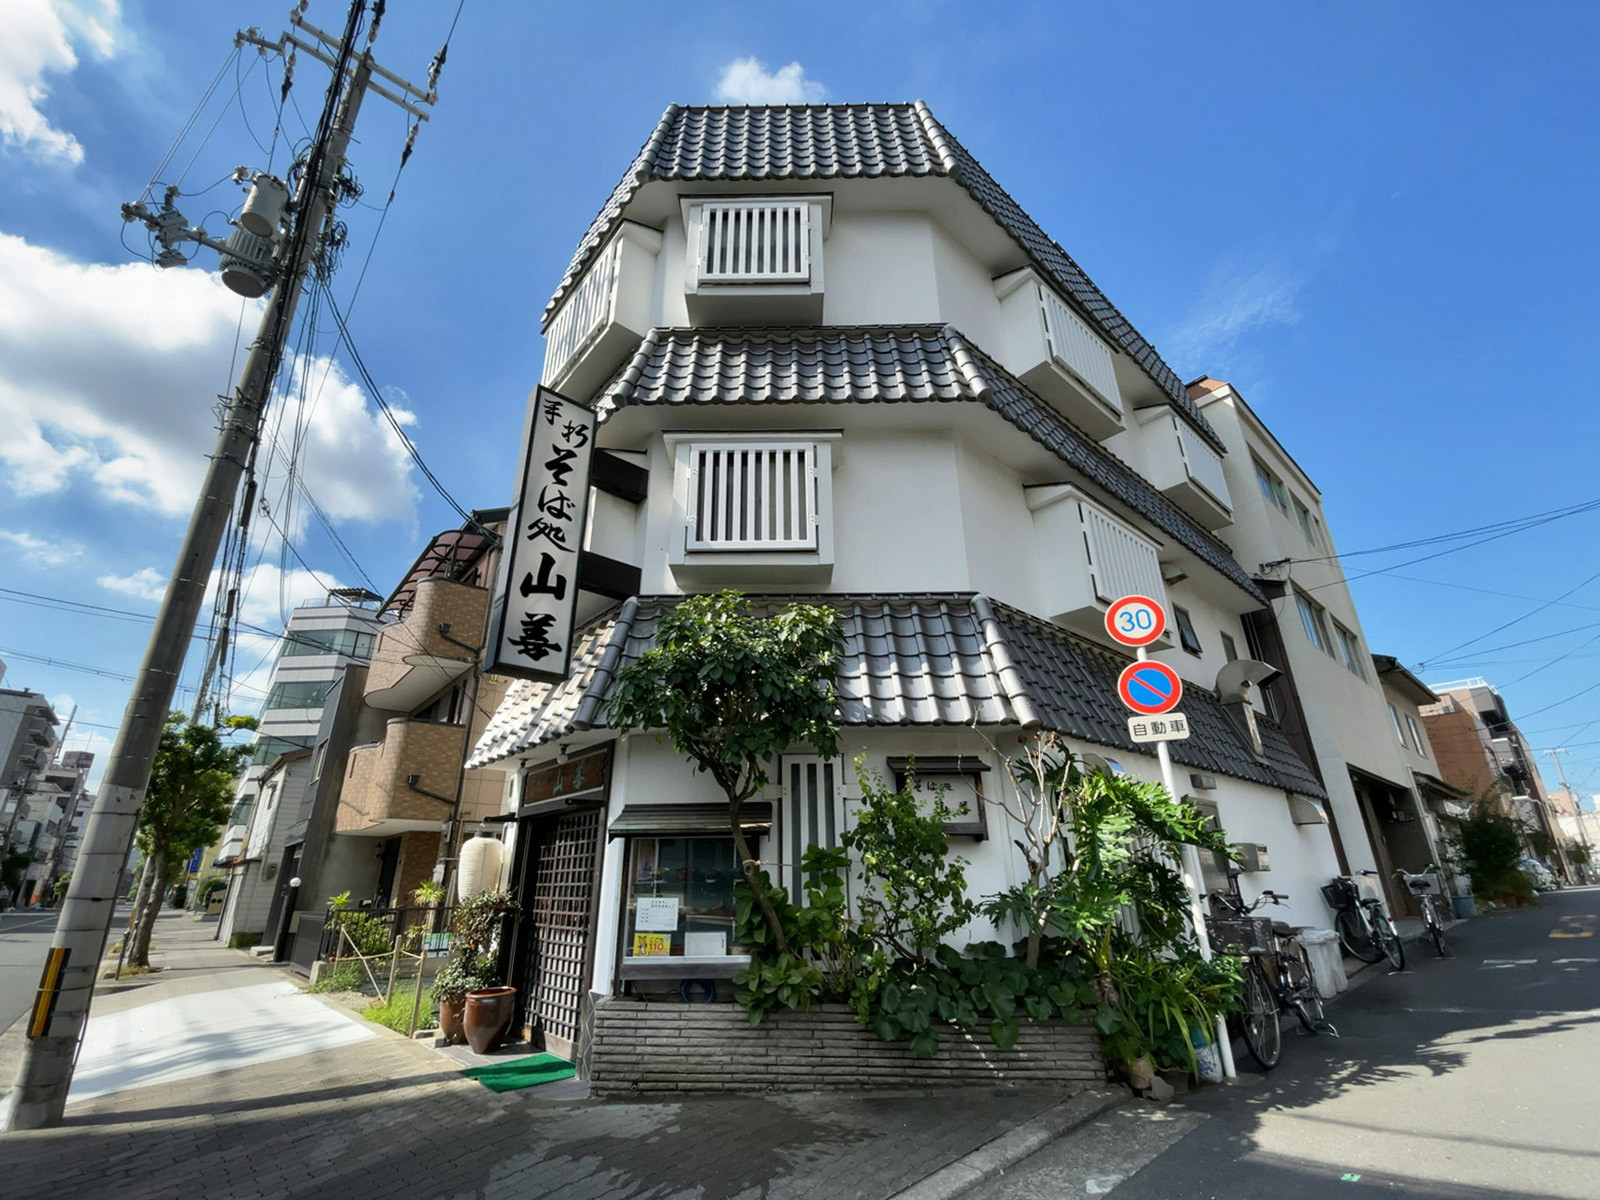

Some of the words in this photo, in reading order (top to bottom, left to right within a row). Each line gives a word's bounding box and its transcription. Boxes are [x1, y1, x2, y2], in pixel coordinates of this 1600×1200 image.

[1119, 608, 1152, 632] 30
[1133, 719, 1186, 737] 自動車
